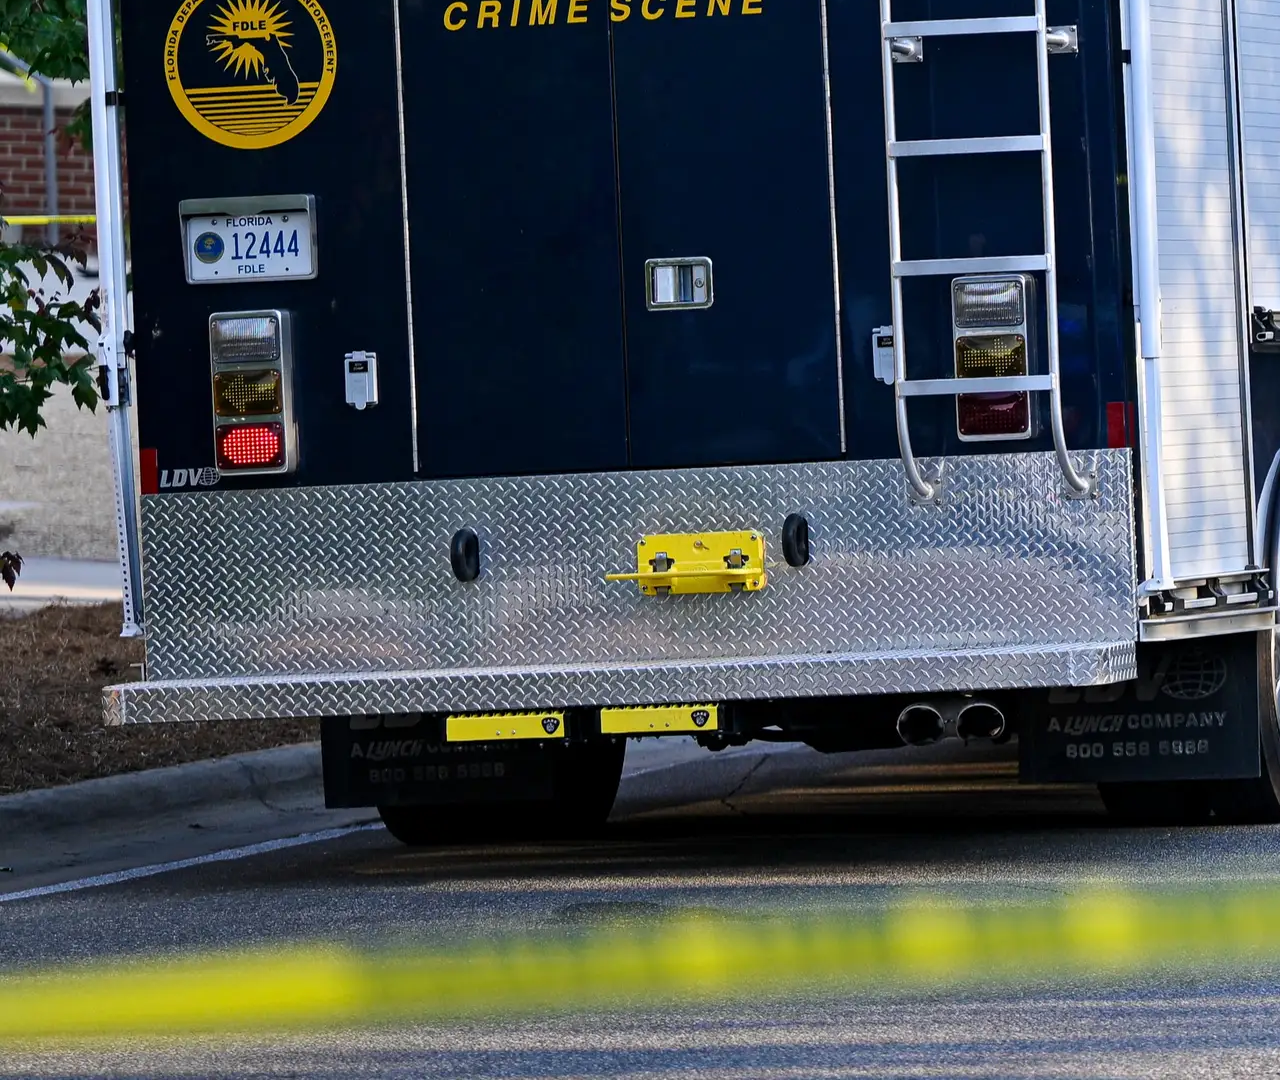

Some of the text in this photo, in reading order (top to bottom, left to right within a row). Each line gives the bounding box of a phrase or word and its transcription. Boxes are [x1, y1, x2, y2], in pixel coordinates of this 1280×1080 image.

[232, 20, 267, 32] FDLE
[166, 29, 180, 81] FLORIDA
[226, 216, 273, 228] FLORIDA
[231, 229, 299, 260] 12444
[238, 264, 265, 274] FDLE
[160, 467, 203, 488] LDV
[1047, 710, 1228, 736] A LYNCH COMPANY
[1066, 742, 1104, 758] 800
